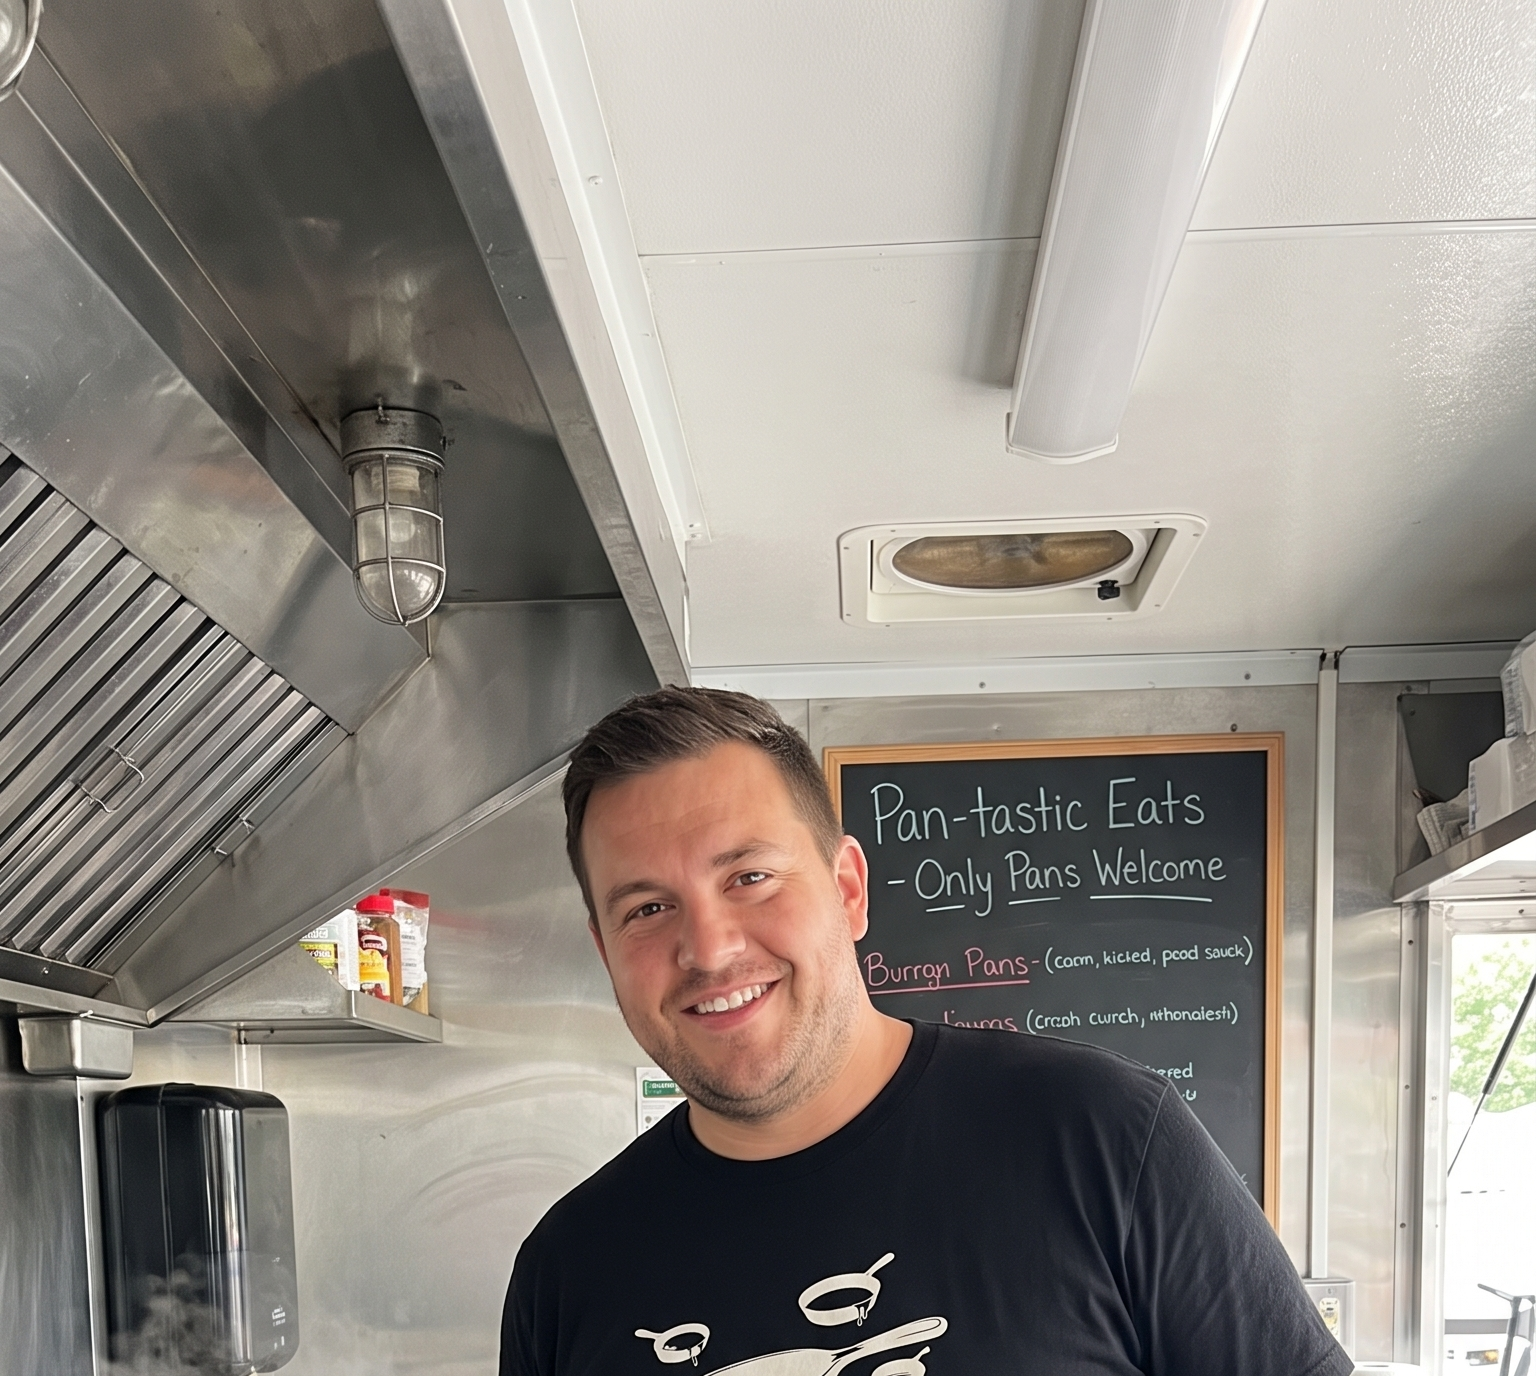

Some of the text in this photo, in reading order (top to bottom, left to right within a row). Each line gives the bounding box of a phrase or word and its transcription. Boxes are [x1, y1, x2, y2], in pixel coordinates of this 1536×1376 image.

[871, 778, 1204, 844] Pan-tastic Eats
[1005, 851, 1081, 891] Pans
[1093, 847, 1226, 885] Welcome
